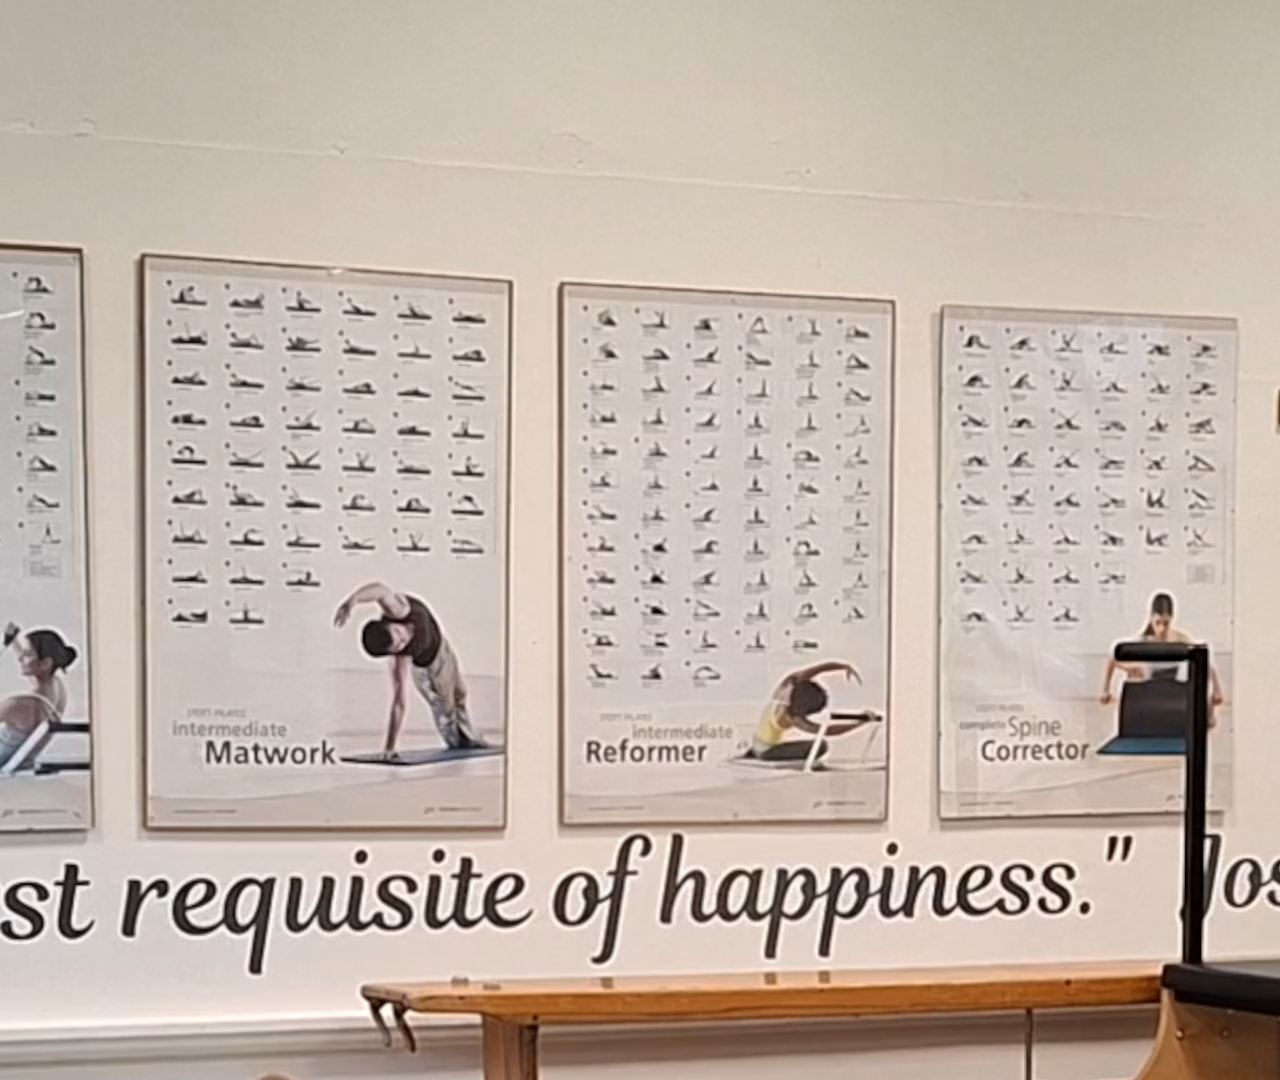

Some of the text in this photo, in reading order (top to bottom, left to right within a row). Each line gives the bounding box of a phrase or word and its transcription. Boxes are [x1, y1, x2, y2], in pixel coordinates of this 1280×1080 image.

[172, 719, 287, 738] intermediate
[632, 724, 733, 739] intermediate
[1007, 715, 1062, 740] Spine
[205, 739, 336, 765] Matwork
[586, 738, 708, 764] Reformer
[980, 738, 1090, 763] Corrector
[121, 849, 533, 975] requisite
[552, 833, 653, 965] of
[659, 832, 1133, 960] happiness."
